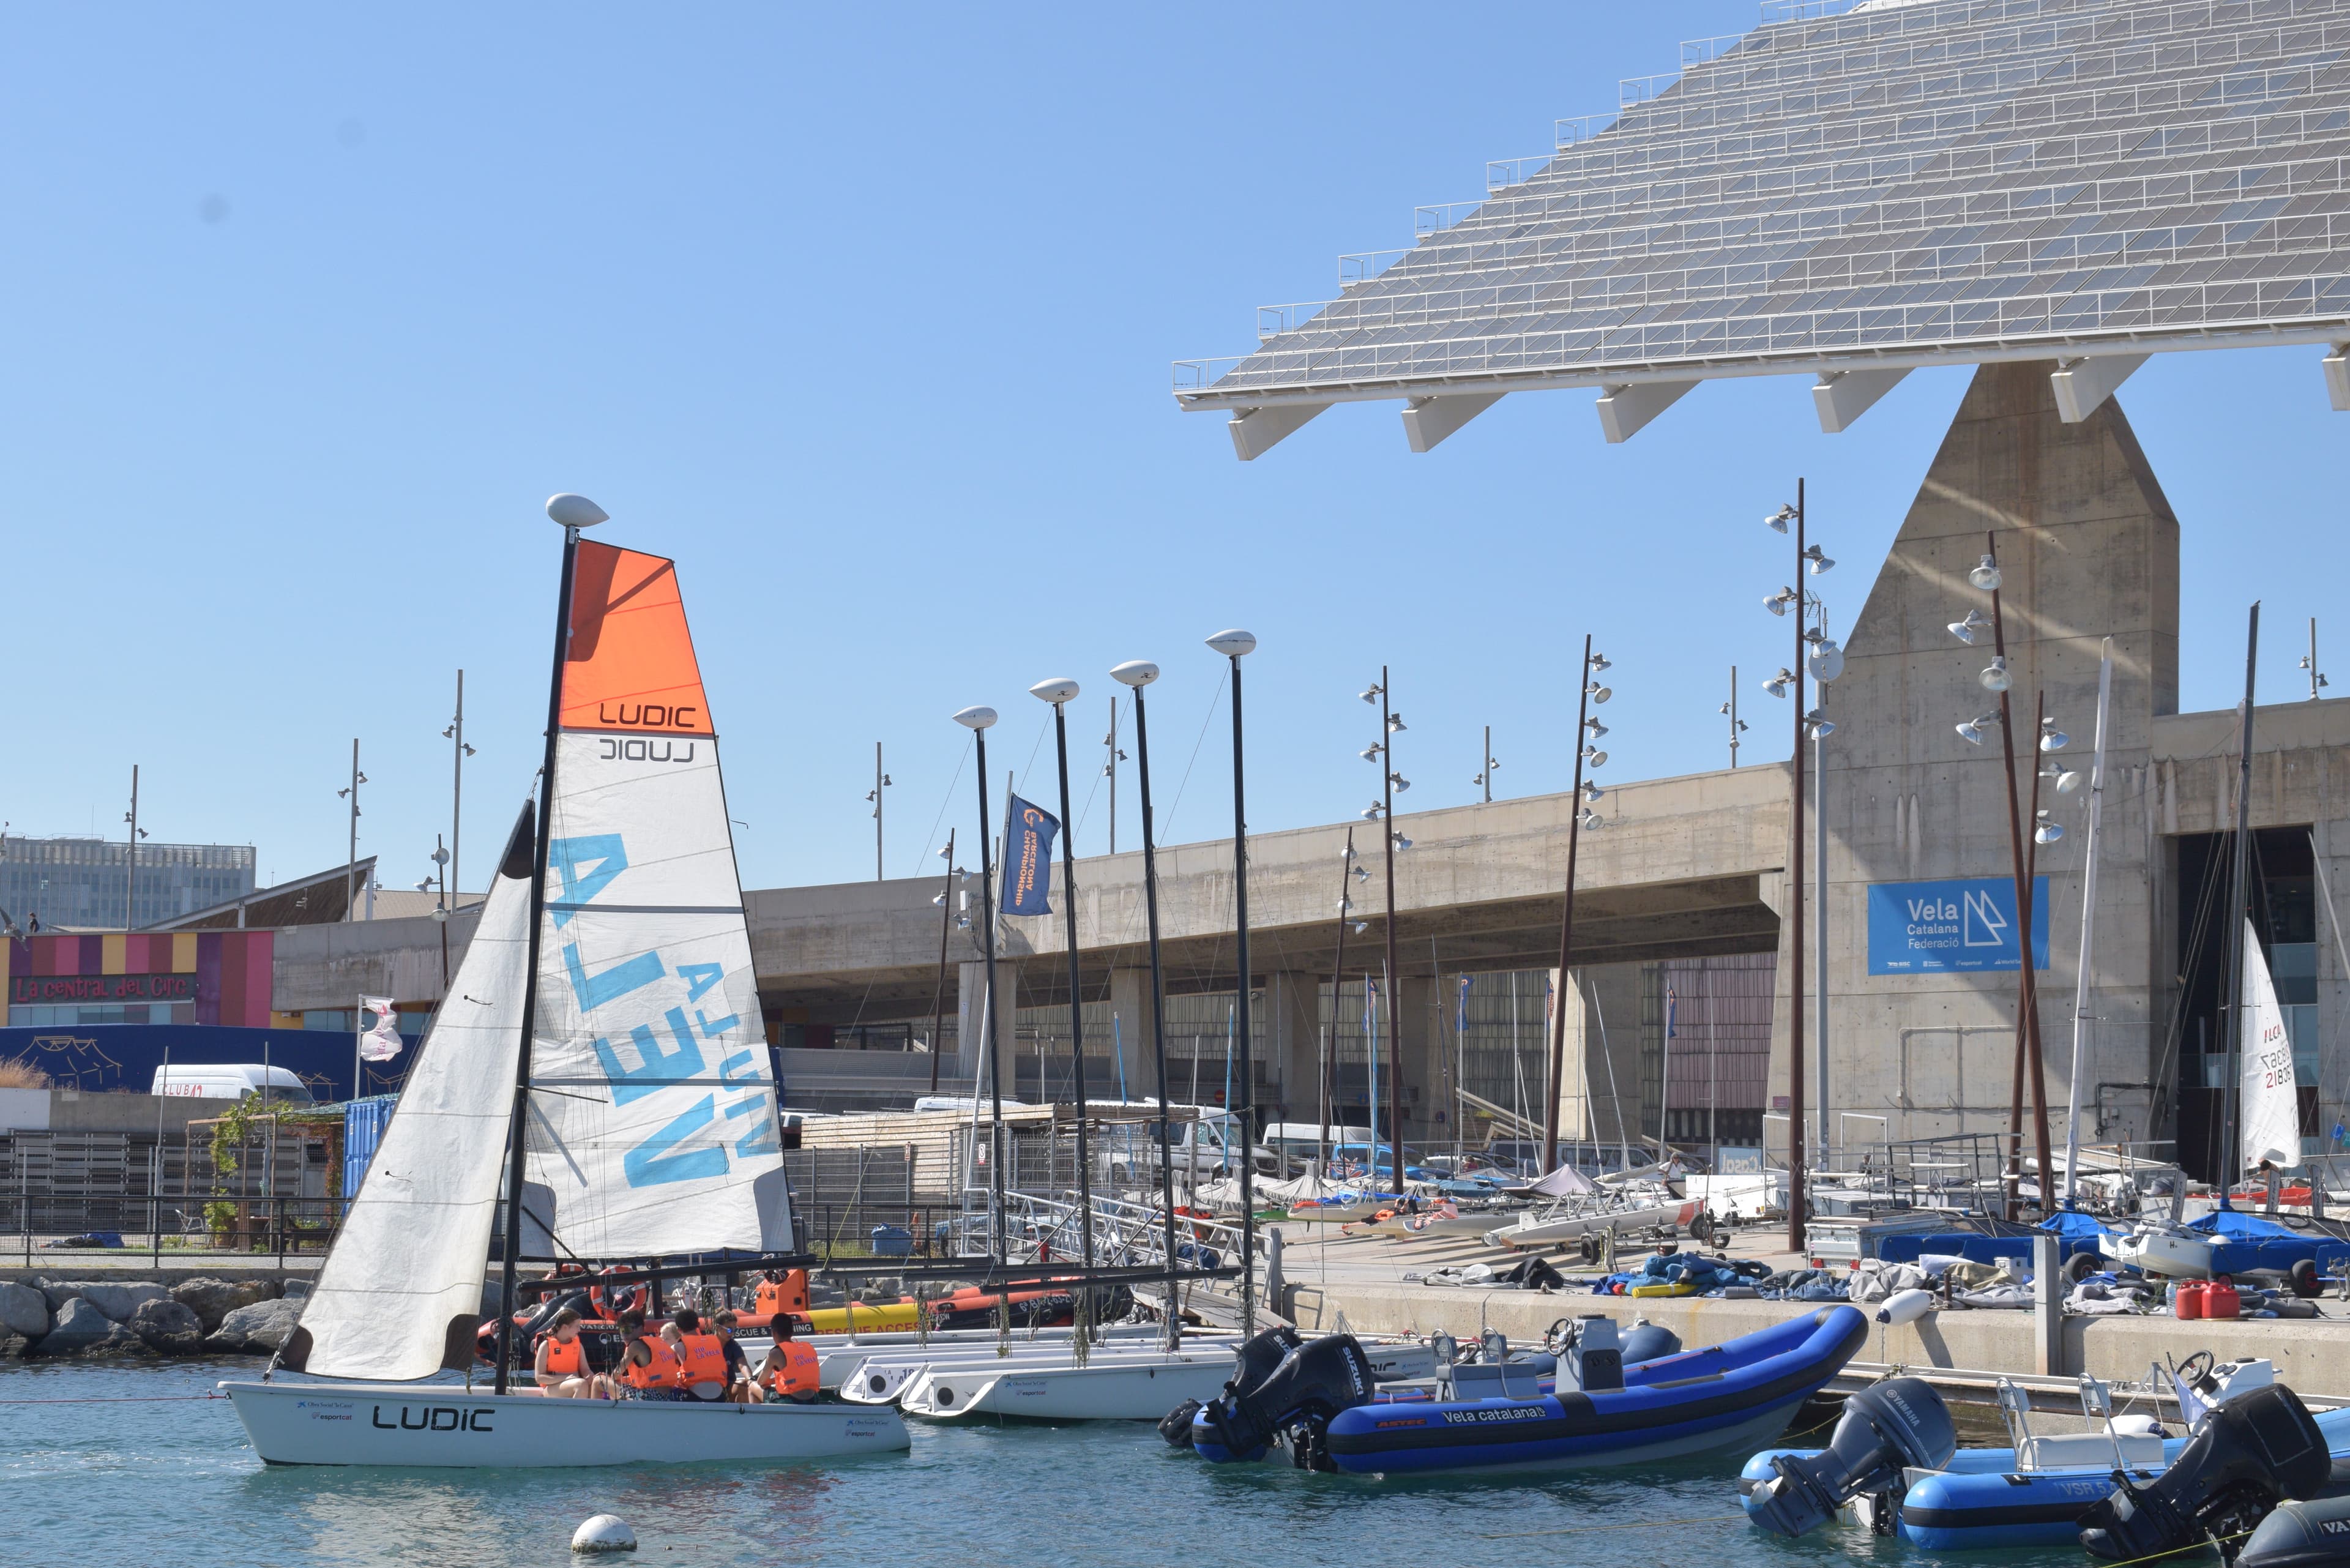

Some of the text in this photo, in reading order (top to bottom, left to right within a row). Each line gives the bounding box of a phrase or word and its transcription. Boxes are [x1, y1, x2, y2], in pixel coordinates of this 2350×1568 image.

[600, 703, 696, 728] LUDIC
[1907, 898, 1958, 921] Vela
[1907, 924, 1958, 935] Catalana
[1909, 937, 1958, 949] Federació
[17, 978, 38, 1002] La
[151, 976, 186, 997] Circ
[2264, 1024, 2281, 1043] ILCA
[734, 1327, 759, 1337] SCUE
[1274, 1334, 1292, 1355] SUZ
[1342, 1346, 1365, 1396] SUZUKI
[373, 1405, 495, 1432] LUDIC
[1442, 1406, 1538, 1424] Vela catalana
[1893, 1395, 1920, 1427] YAMAHA
[1378, 1419, 1425, 1428] ASTEC
[2061, 1482, 2095, 1495] VSR
